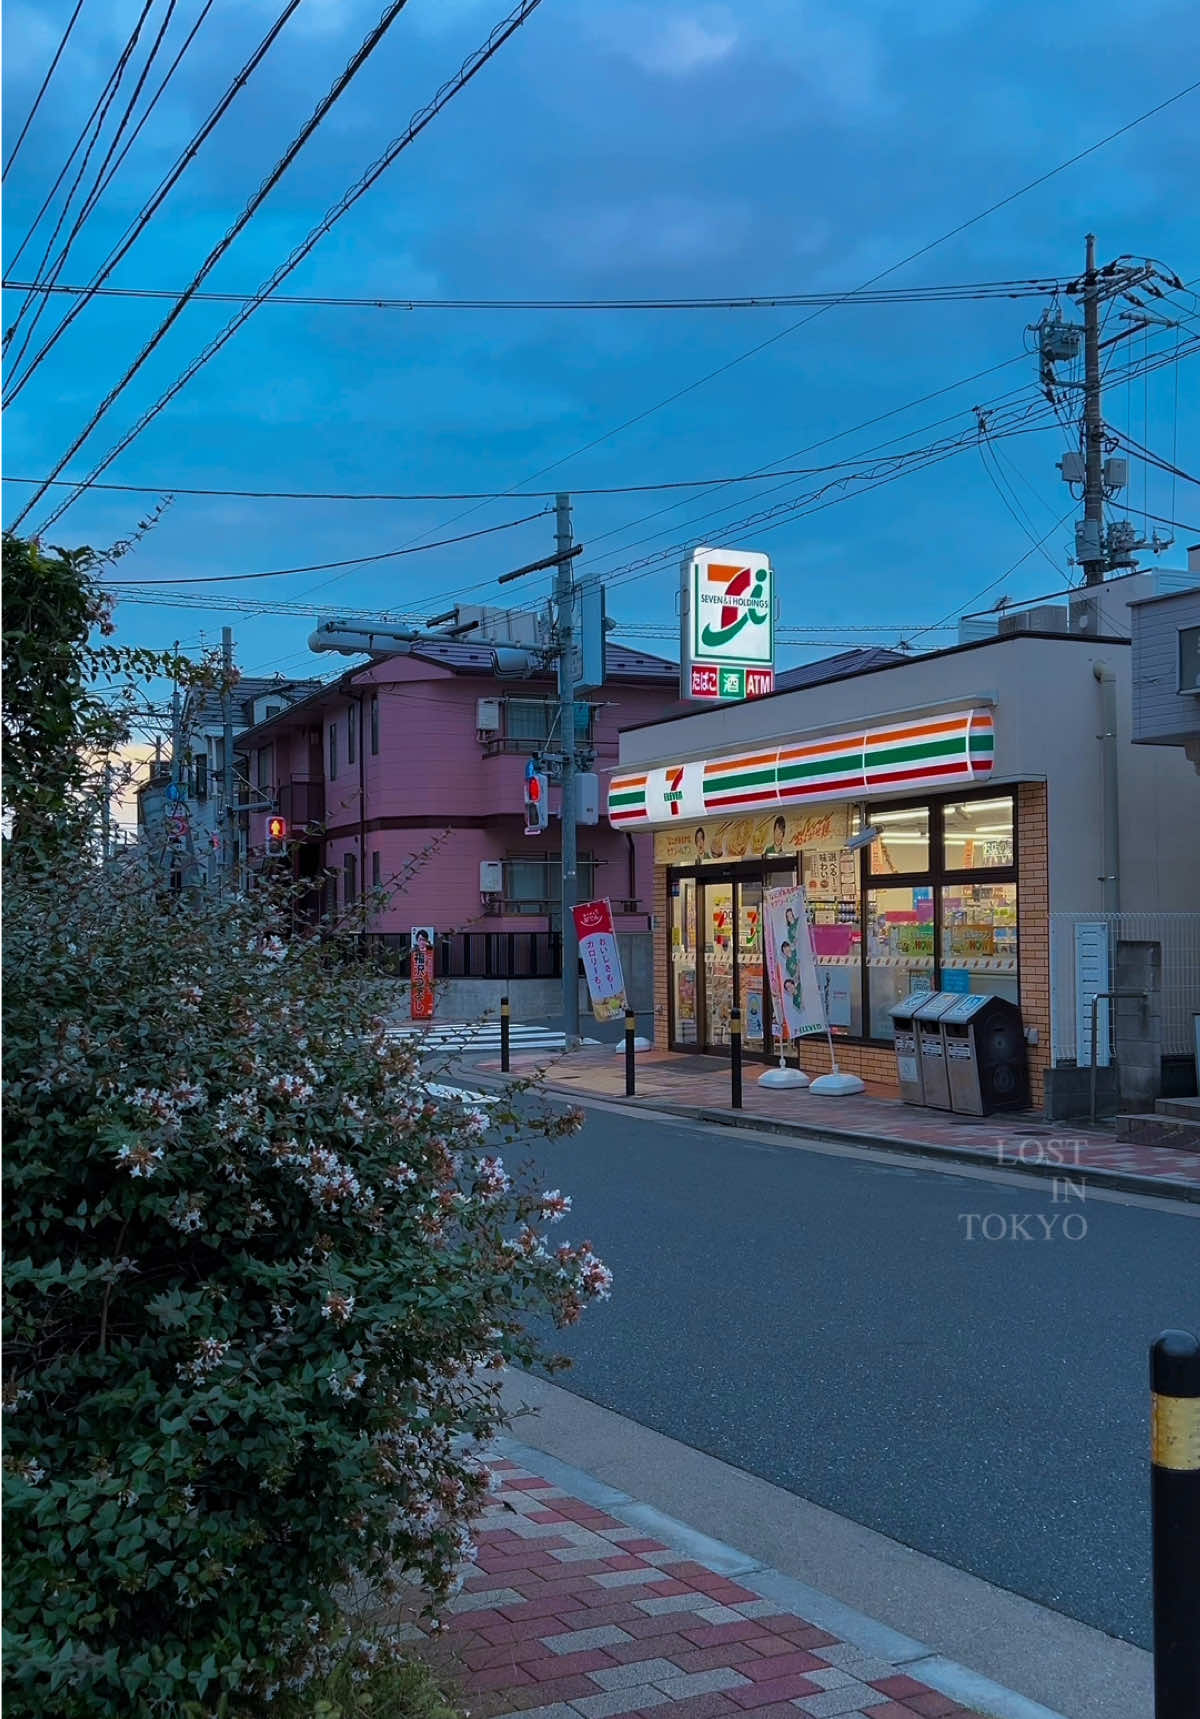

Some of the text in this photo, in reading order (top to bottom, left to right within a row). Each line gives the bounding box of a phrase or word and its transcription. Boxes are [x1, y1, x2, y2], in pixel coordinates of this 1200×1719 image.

[733, 597, 769, 608] HOLDINGS
[692, 671, 717, 692] たばこ
[723, 673, 740, 693] 酒
[747, 674, 770, 695] ATM
